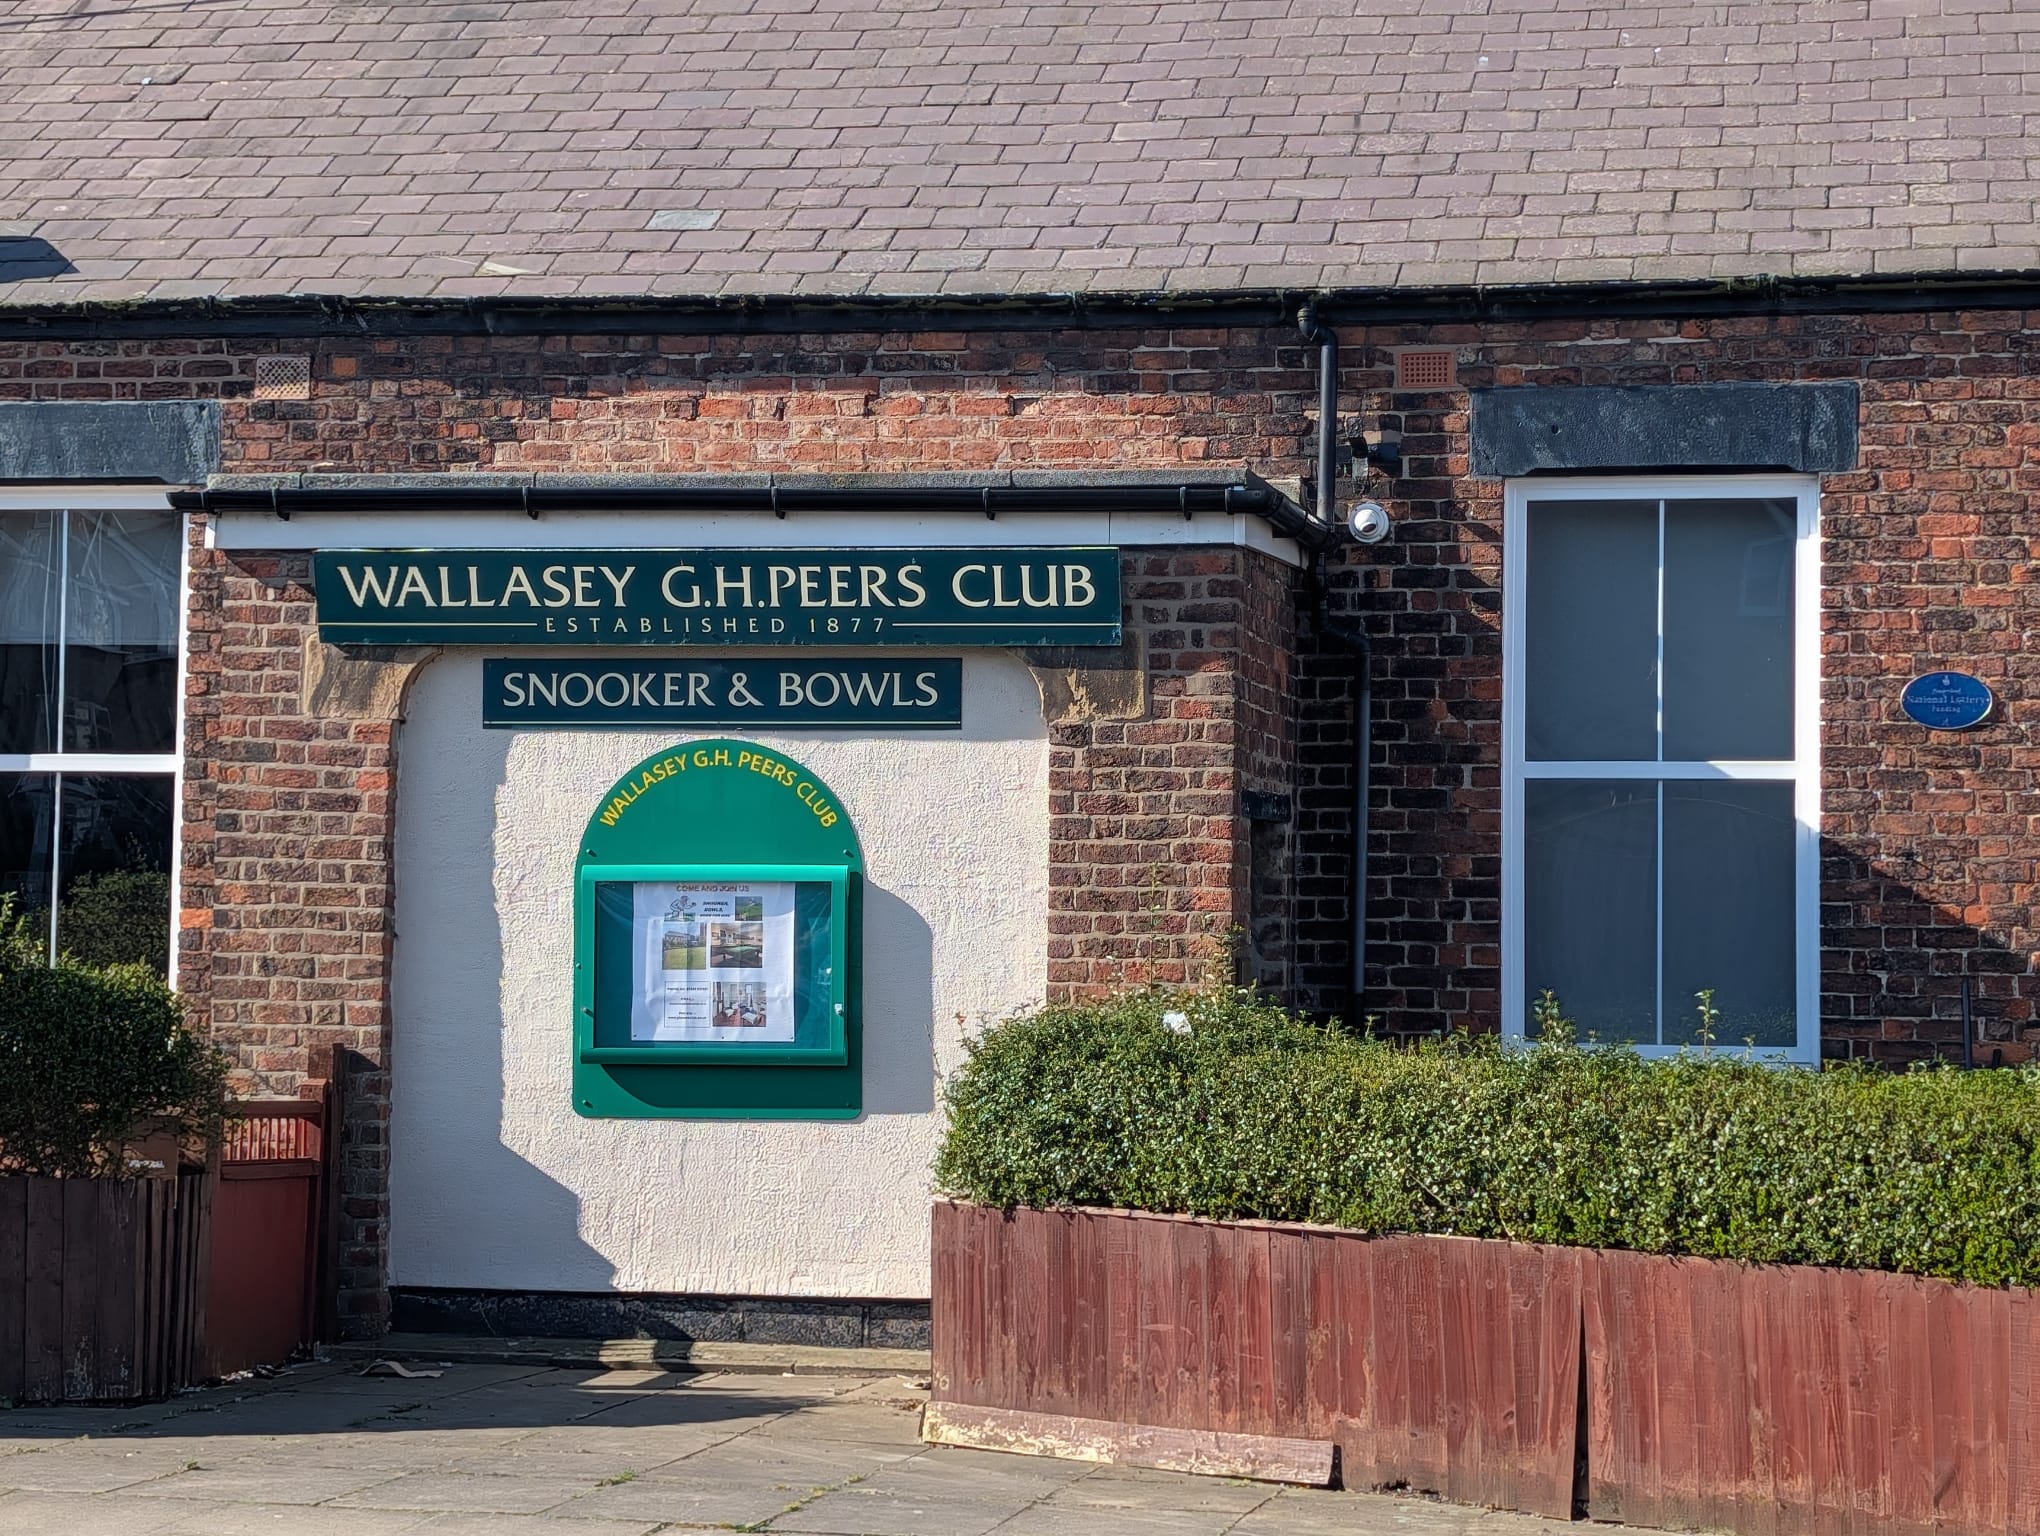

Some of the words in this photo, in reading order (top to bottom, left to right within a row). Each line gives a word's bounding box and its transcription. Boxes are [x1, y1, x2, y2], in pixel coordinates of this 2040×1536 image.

[336, 565, 636, 609] WALLASEY
[951, 564, 1097, 608] CLUB
[545, 616, 786, 634] ESTABLISHED
[809, 616, 885, 634] 1877
[502, 671, 717, 708] SNOOKER
[727, 671, 766, 708] &
[778, 671, 939, 708] BOWLS
[599, 753, 688, 828] WALLASEY
[693, 749, 733, 768] G.H.
[737, 750, 798, 788] PEERS
[795, 781, 838, 829] CLUB
[676, 884, 700, 892] COME
[700, 884, 718, 892] AND
[719, 884, 738, 892] JOIN
[739, 884, 750, 892] US
